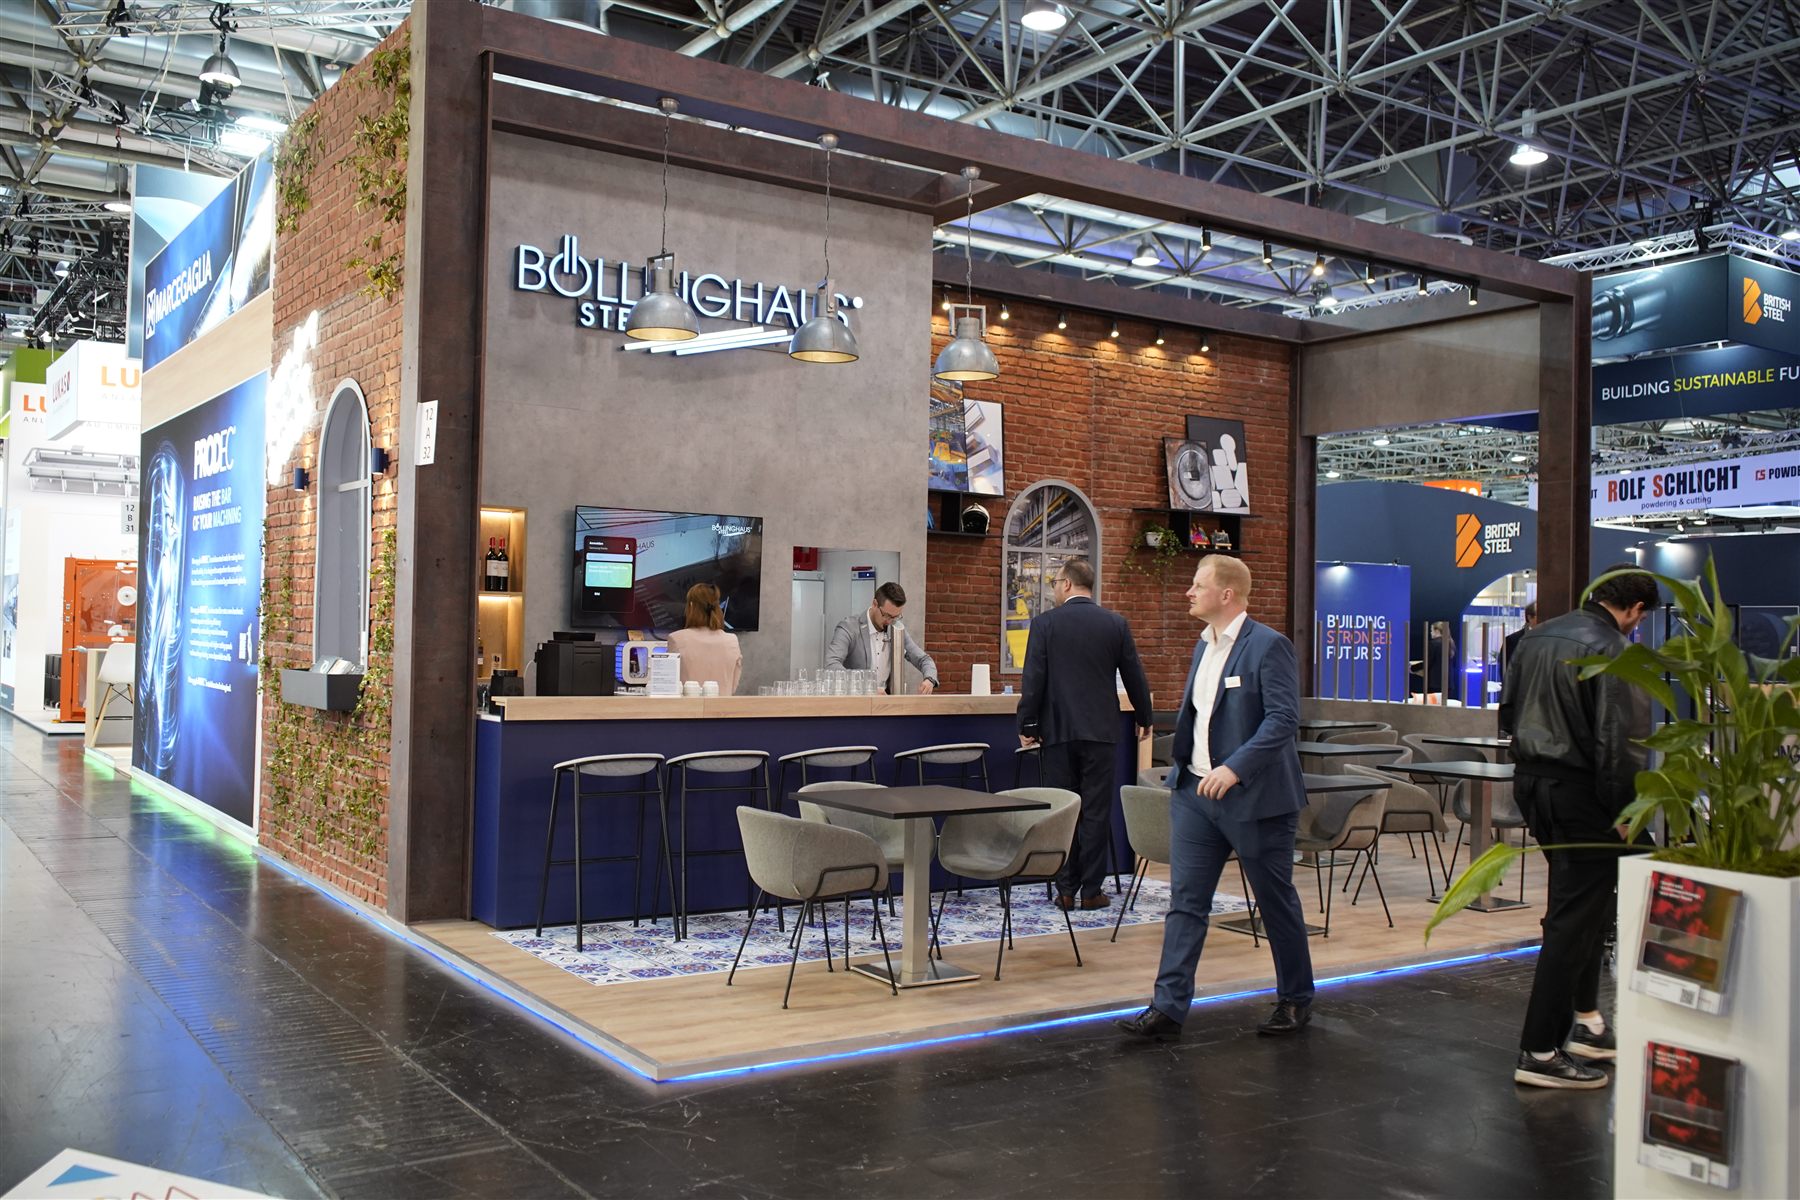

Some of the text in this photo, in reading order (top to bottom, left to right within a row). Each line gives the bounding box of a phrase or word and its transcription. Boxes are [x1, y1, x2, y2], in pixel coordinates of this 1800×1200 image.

[155, 250, 213, 324] MARCEGAGLIA
[517, 234, 849, 328] BÖLLGHAS
[1763, 293, 1791, 311] BRITISH
[580, 302, 632, 331] STE
[1763, 307, 1785, 322] STEEL
[1601, 380, 1670, 401] BUILDING
[1673, 368, 1775, 392] SUSTAINABLE
[425, 407, 434, 421] 12
[425, 427, 431, 440] A
[193, 426, 235, 480] PRODEC
[422, 446, 431, 460] 32
[1607, 465, 1741, 502] ROLF SCHLICHT
[221, 486, 232, 505] BAR
[1641, 499, 1677, 510] powdering
[1686, 496, 1712, 506] cutting
[125, 504, 135, 512] 12
[125, 524, 134, 532] 31
[1485, 522, 1520, 540] BRITISH
[1484, 540, 1512, 554] STEEL
[1327, 614, 1386, 629] BUILDING
